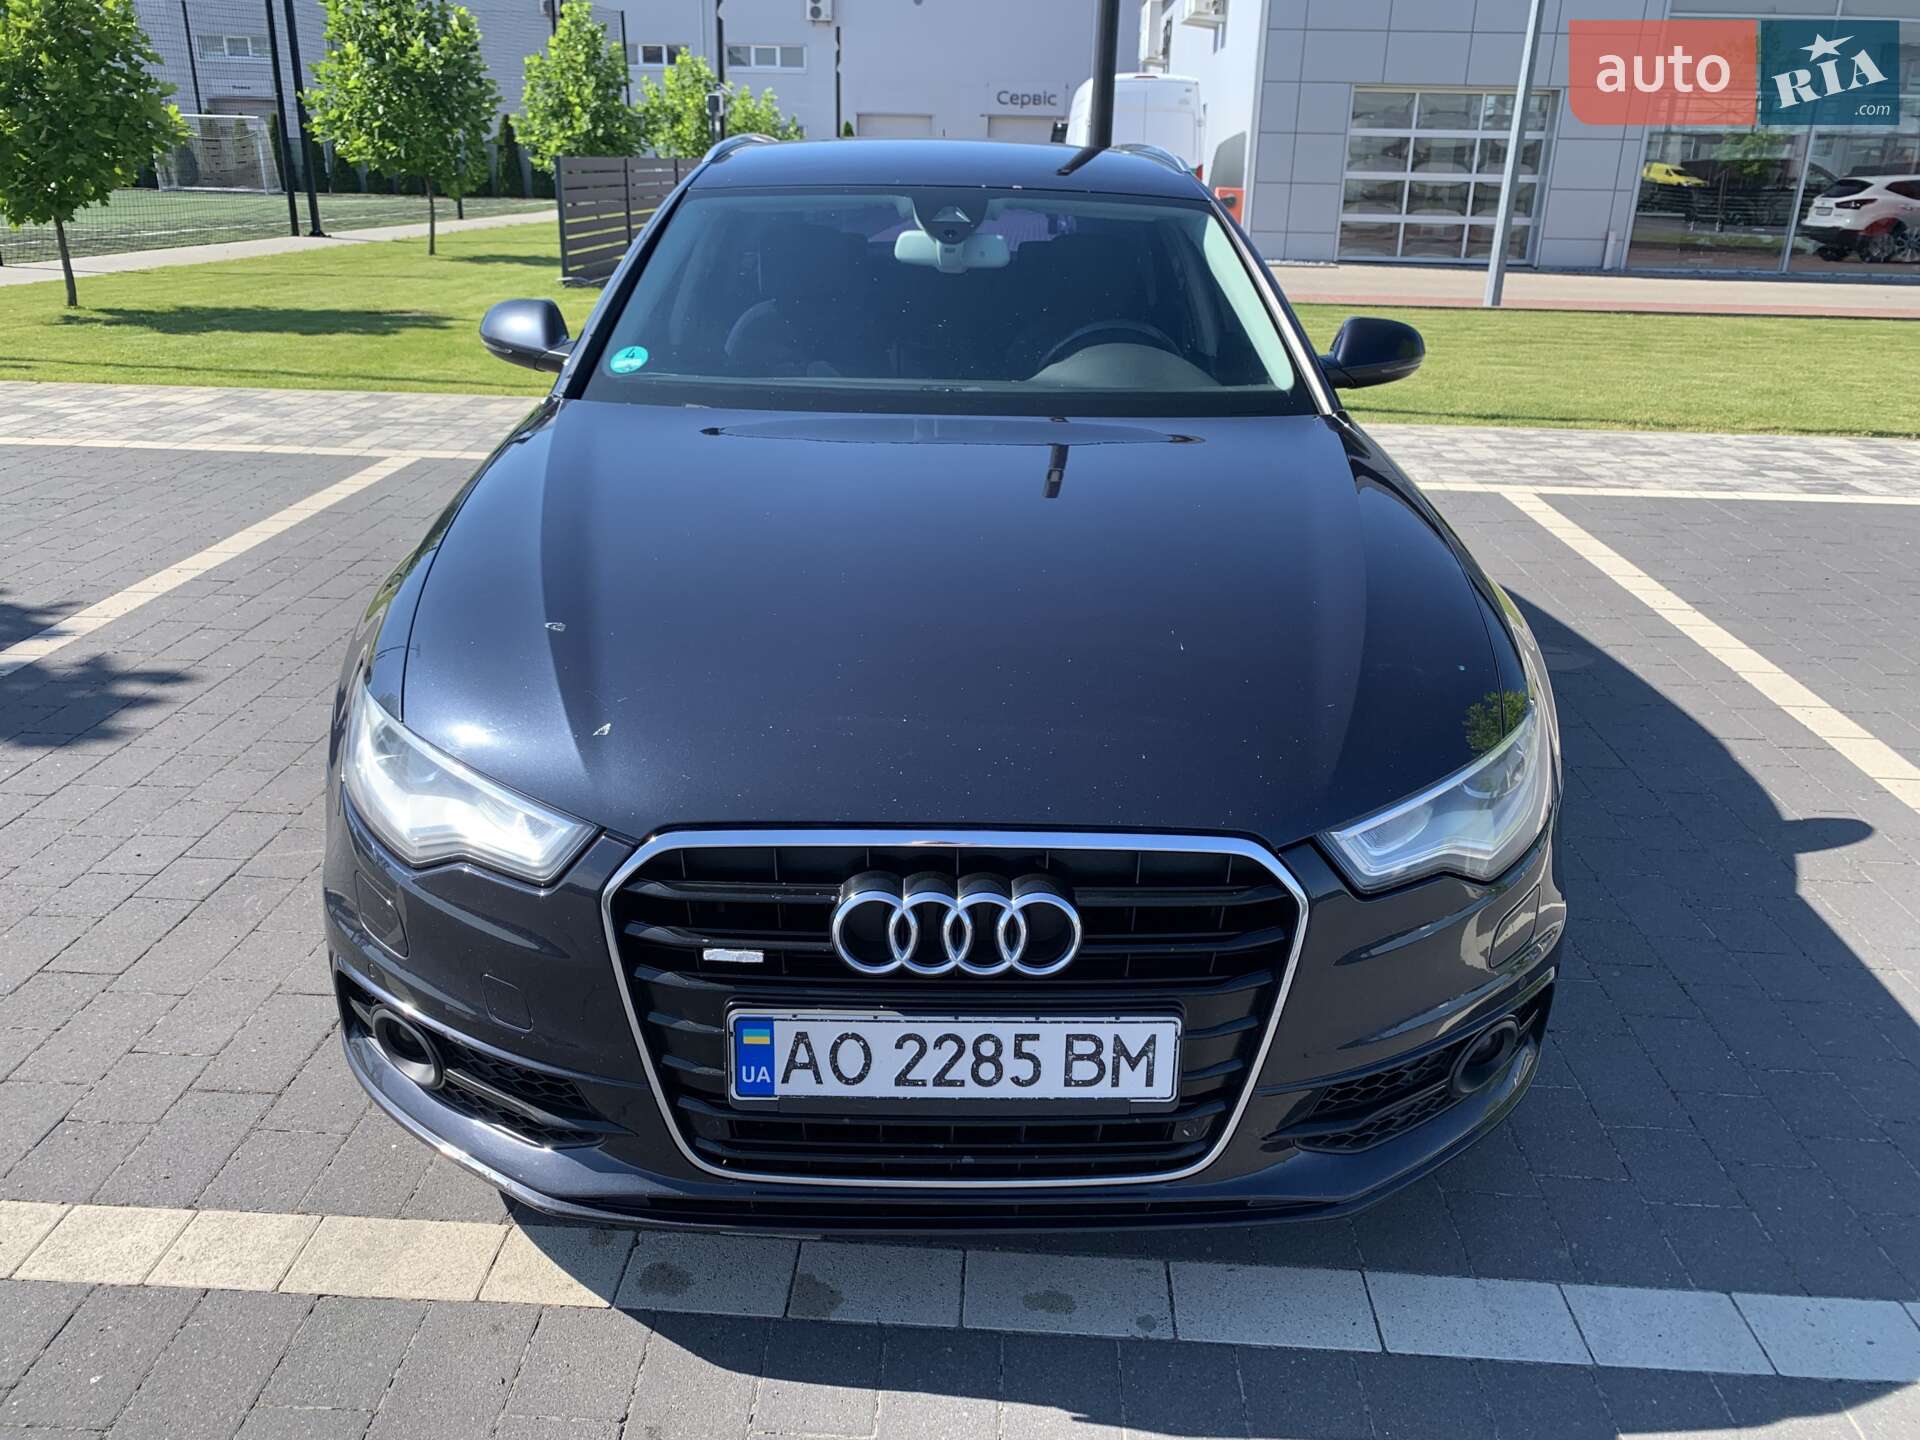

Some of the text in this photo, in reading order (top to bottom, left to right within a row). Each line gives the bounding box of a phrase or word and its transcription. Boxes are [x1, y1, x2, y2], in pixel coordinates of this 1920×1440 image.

[996, 90, 1057, 109] Сервіс
[781, 1031, 1157, 1087] AO 2285 BM
[742, 1065, 771, 1083] UA
